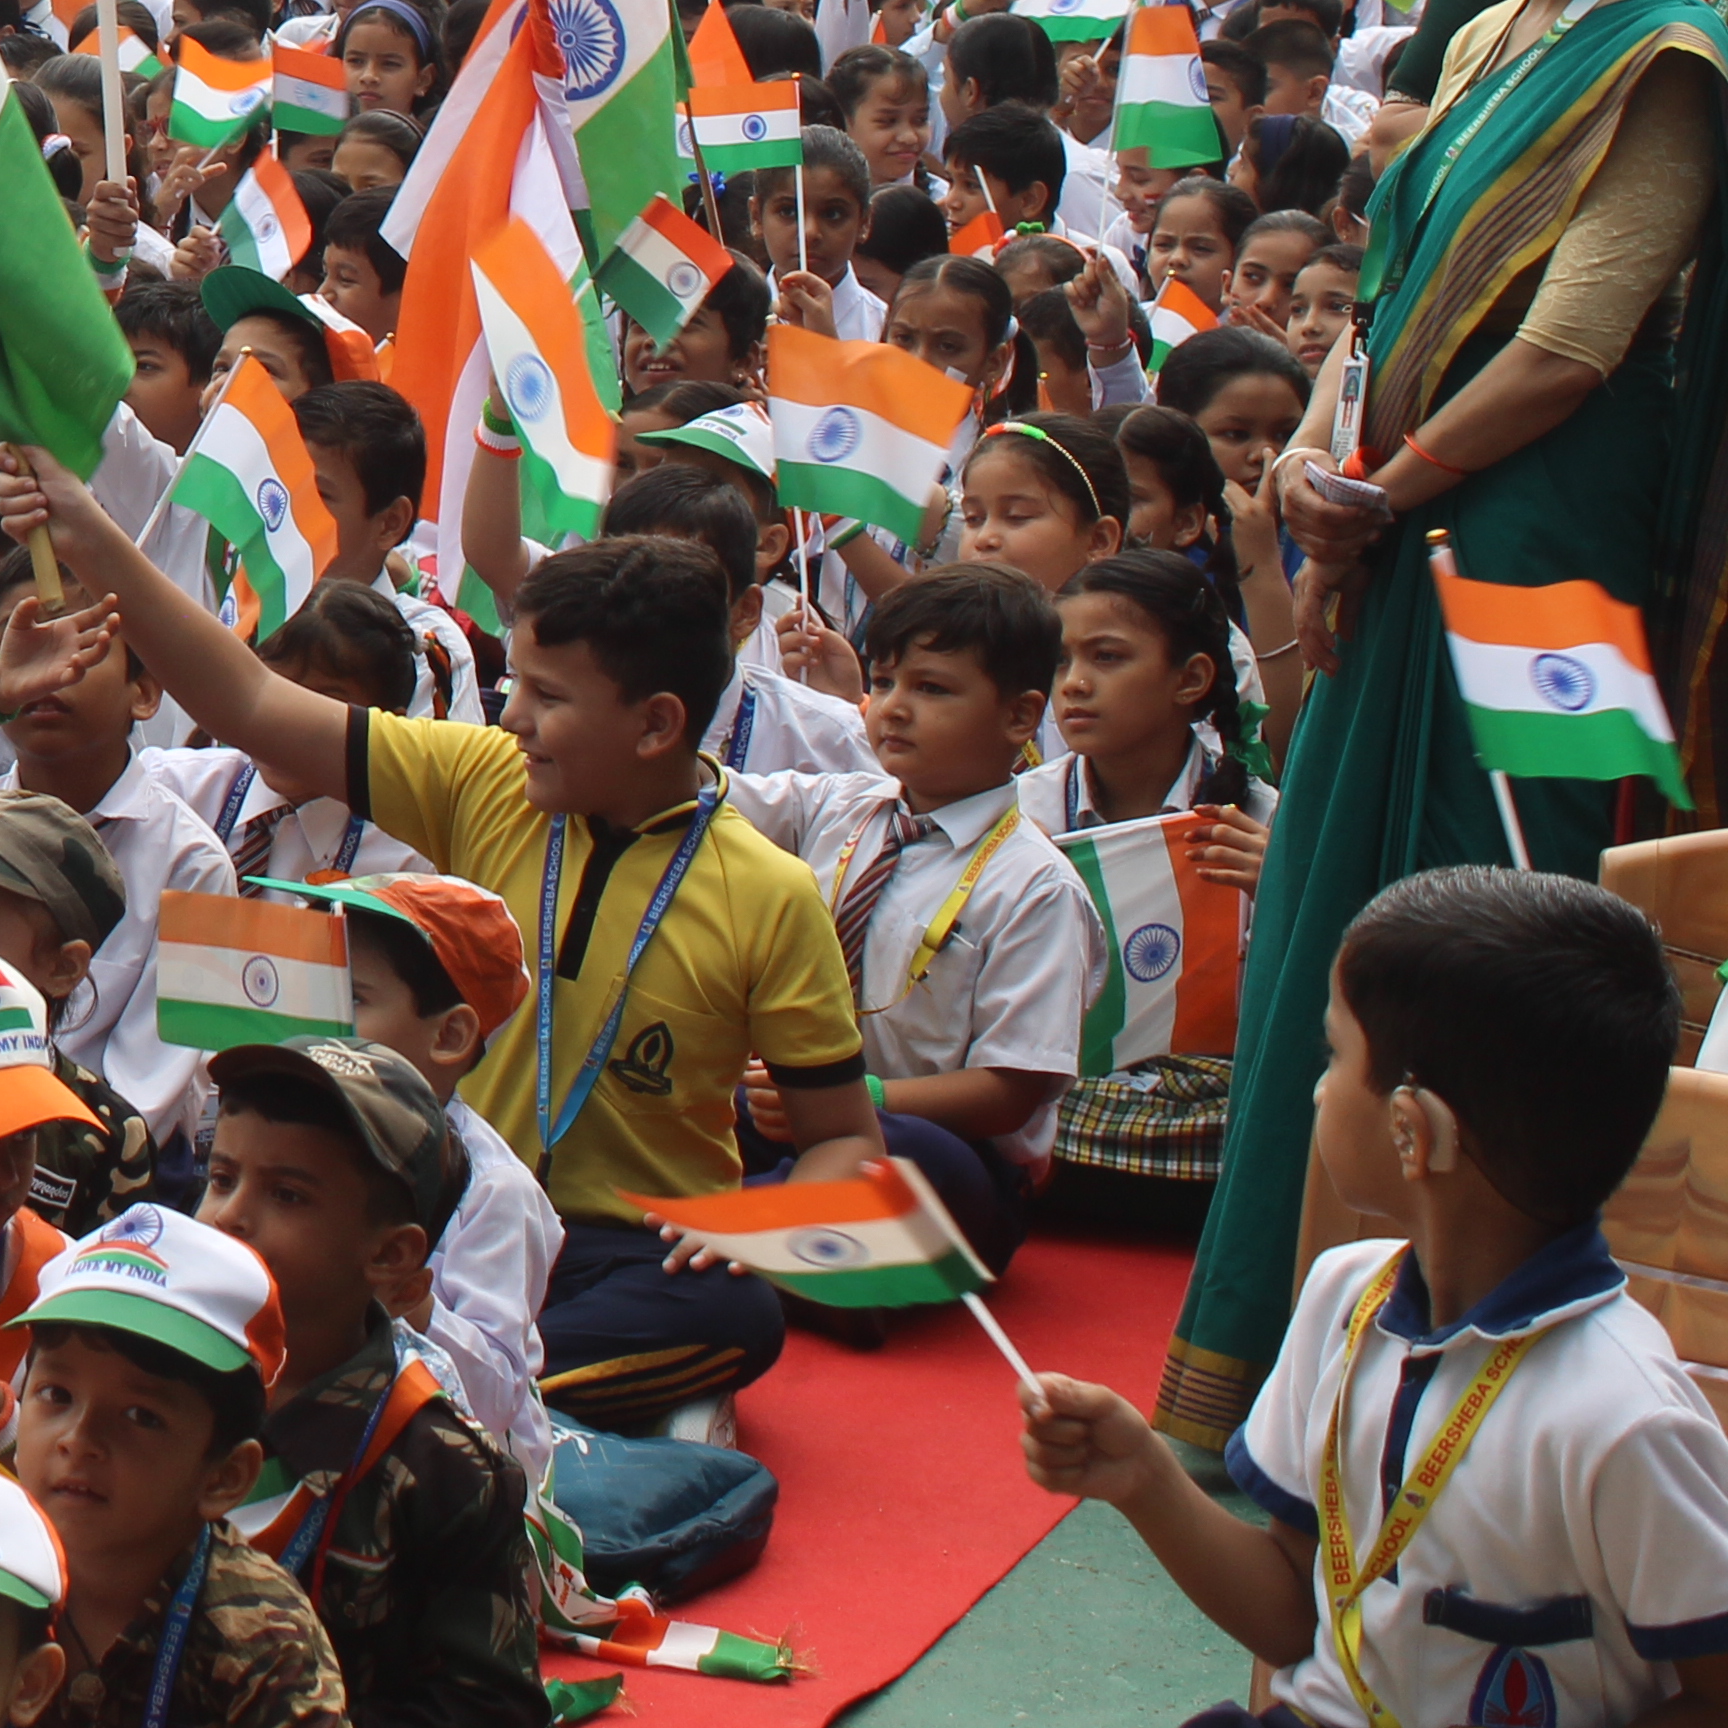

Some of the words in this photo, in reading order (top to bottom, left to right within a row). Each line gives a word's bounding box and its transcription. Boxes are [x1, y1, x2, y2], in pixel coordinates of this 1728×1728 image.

[1455, 85, 1508, 145] BEERSHEBA
[1505, 46, 1543, 90] SCHOOL
[548, 834, 562, 880] SCHOOL
[650, 856, 688, 920] BEERSHEBA
[685, 812, 709, 856] SCHOOL
[543, 880, 556, 955] BEERSHEBA
[541, 975, 551, 1025] SCHOOL
[540, 1030, 551, 1100] BEERSHEBA
[72, 1260, 100, 1273] LOVE
[103, 1260, 124, 1274] MY
[128, 1263, 167, 1288] INDIA
[1418, 1380, 1491, 1489] BEERSHEBA
[1332, 1470, 1352, 1586] BEERSHEBA
[150, 1622, 182, 1716] BEERSHEBA
